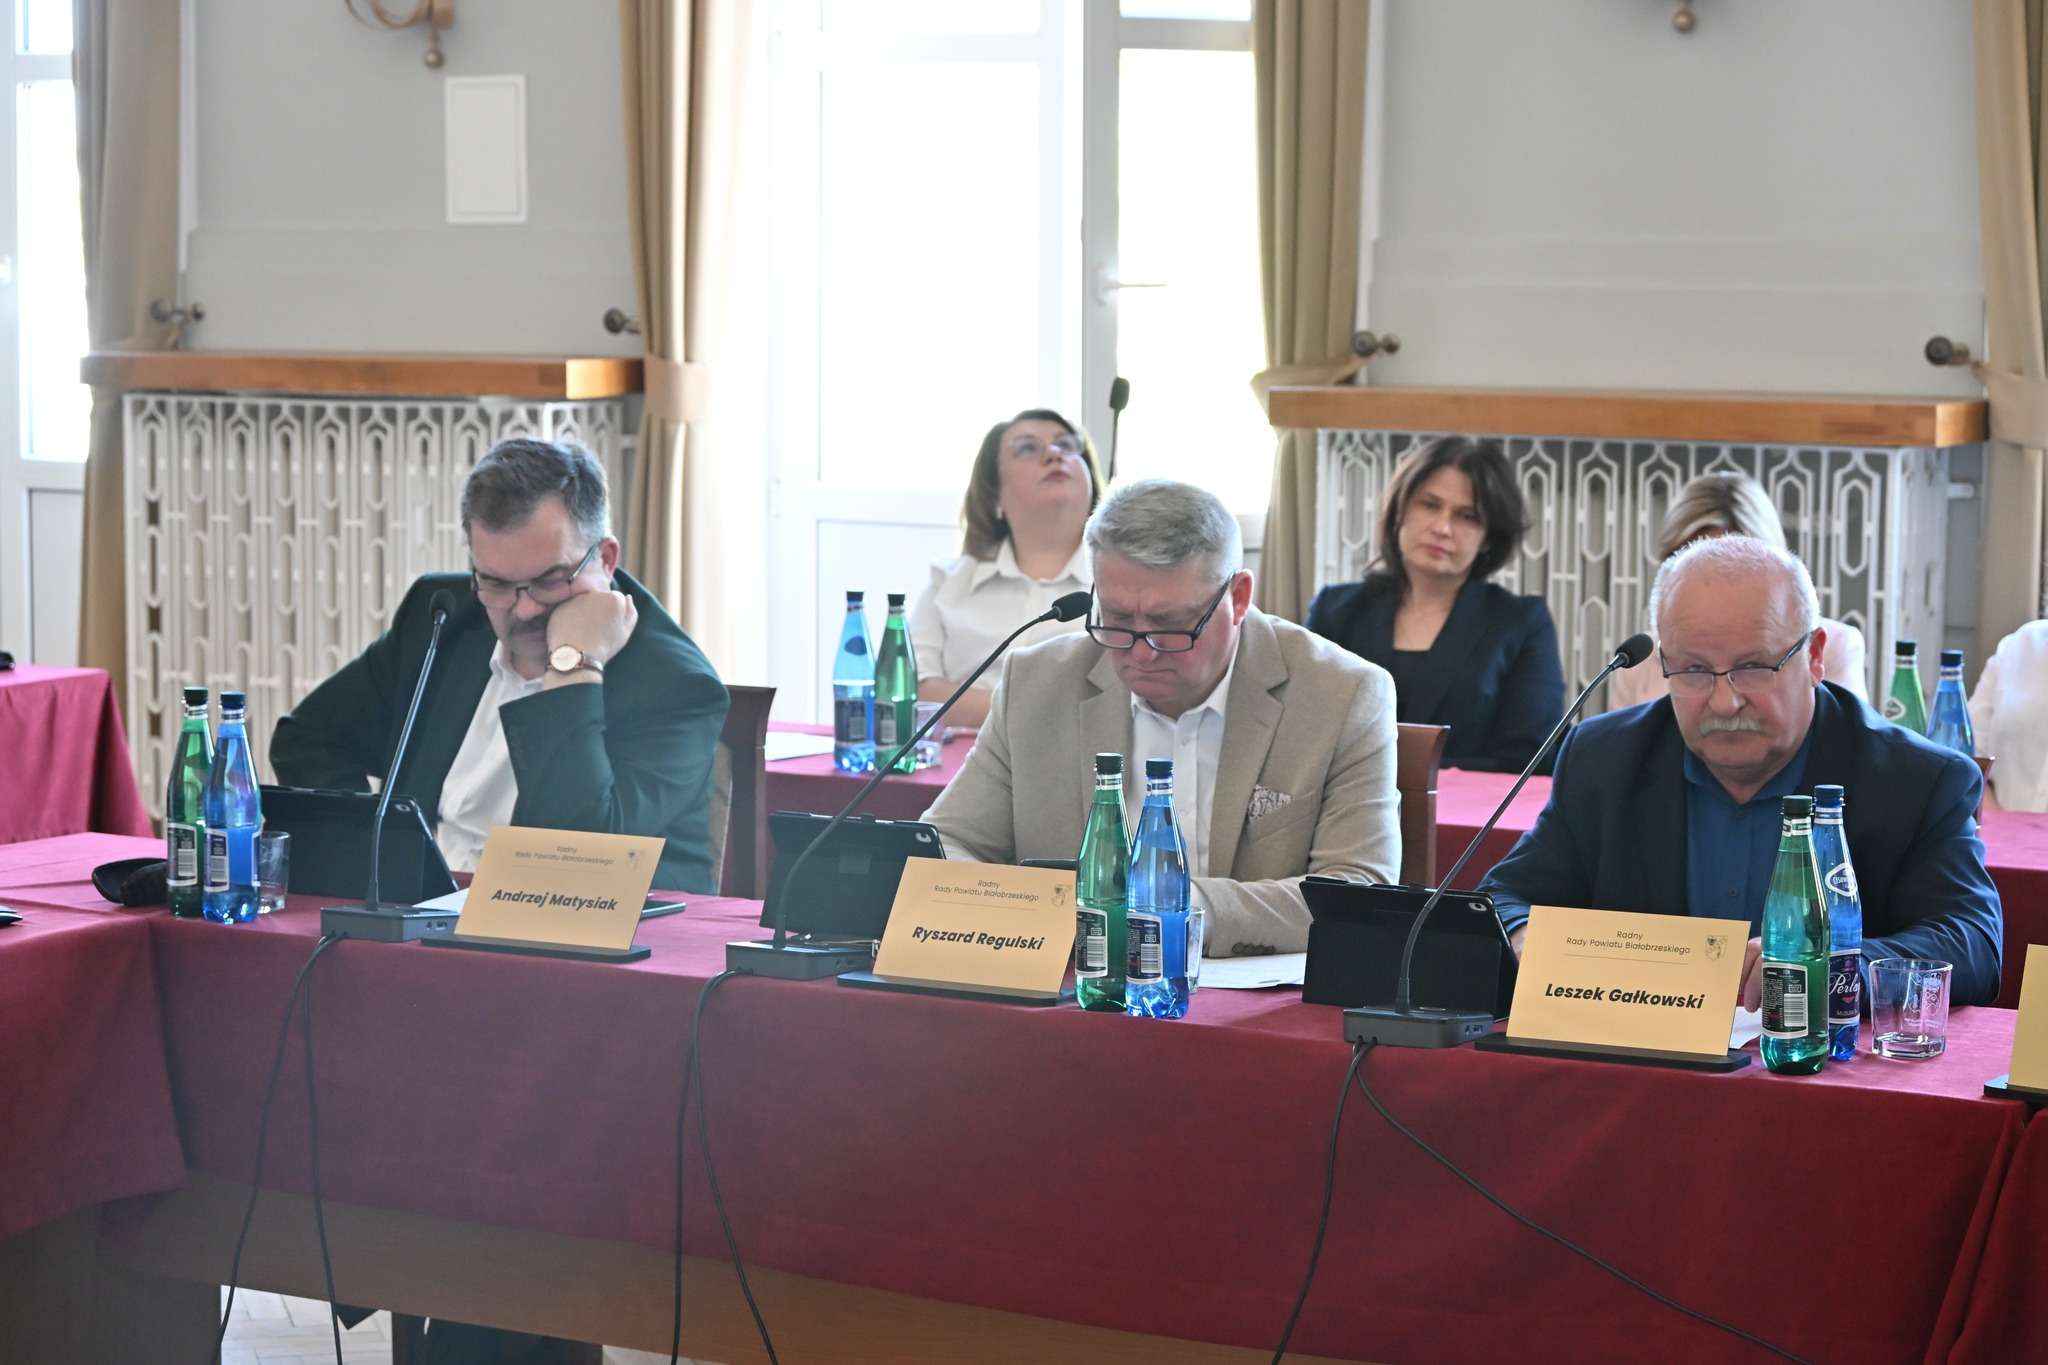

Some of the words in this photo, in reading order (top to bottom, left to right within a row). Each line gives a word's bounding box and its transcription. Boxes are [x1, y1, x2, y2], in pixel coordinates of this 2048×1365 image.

[515, 850, 533, 860] Rady
[533, 852, 560, 861] Powiatu
[556, 846, 578, 854] Radny
[934, 885, 953, 895] Rady
[953, 887, 983, 897] Powiatu
[984, 889, 1040, 902] Białobrzeskiego
[977, 880, 1000, 890] Radny
[491, 890, 549, 907] Andrzej
[549, 894, 618, 912] Matysiak
[912, 926, 975, 943] Ryszard
[976, 933, 1045, 951] Regulski
[1616, 931, 1644, 942] Radny
[1566, 937, 1588, 948] Rady
[1589, 939, 1623, 949] Powiatu
[1625, 941, 1691, 955] Białobrzeskiego
[1545, 983, 1606, 1002] Leszek
[1609, 988, 1706, 1009] Gałkowski
